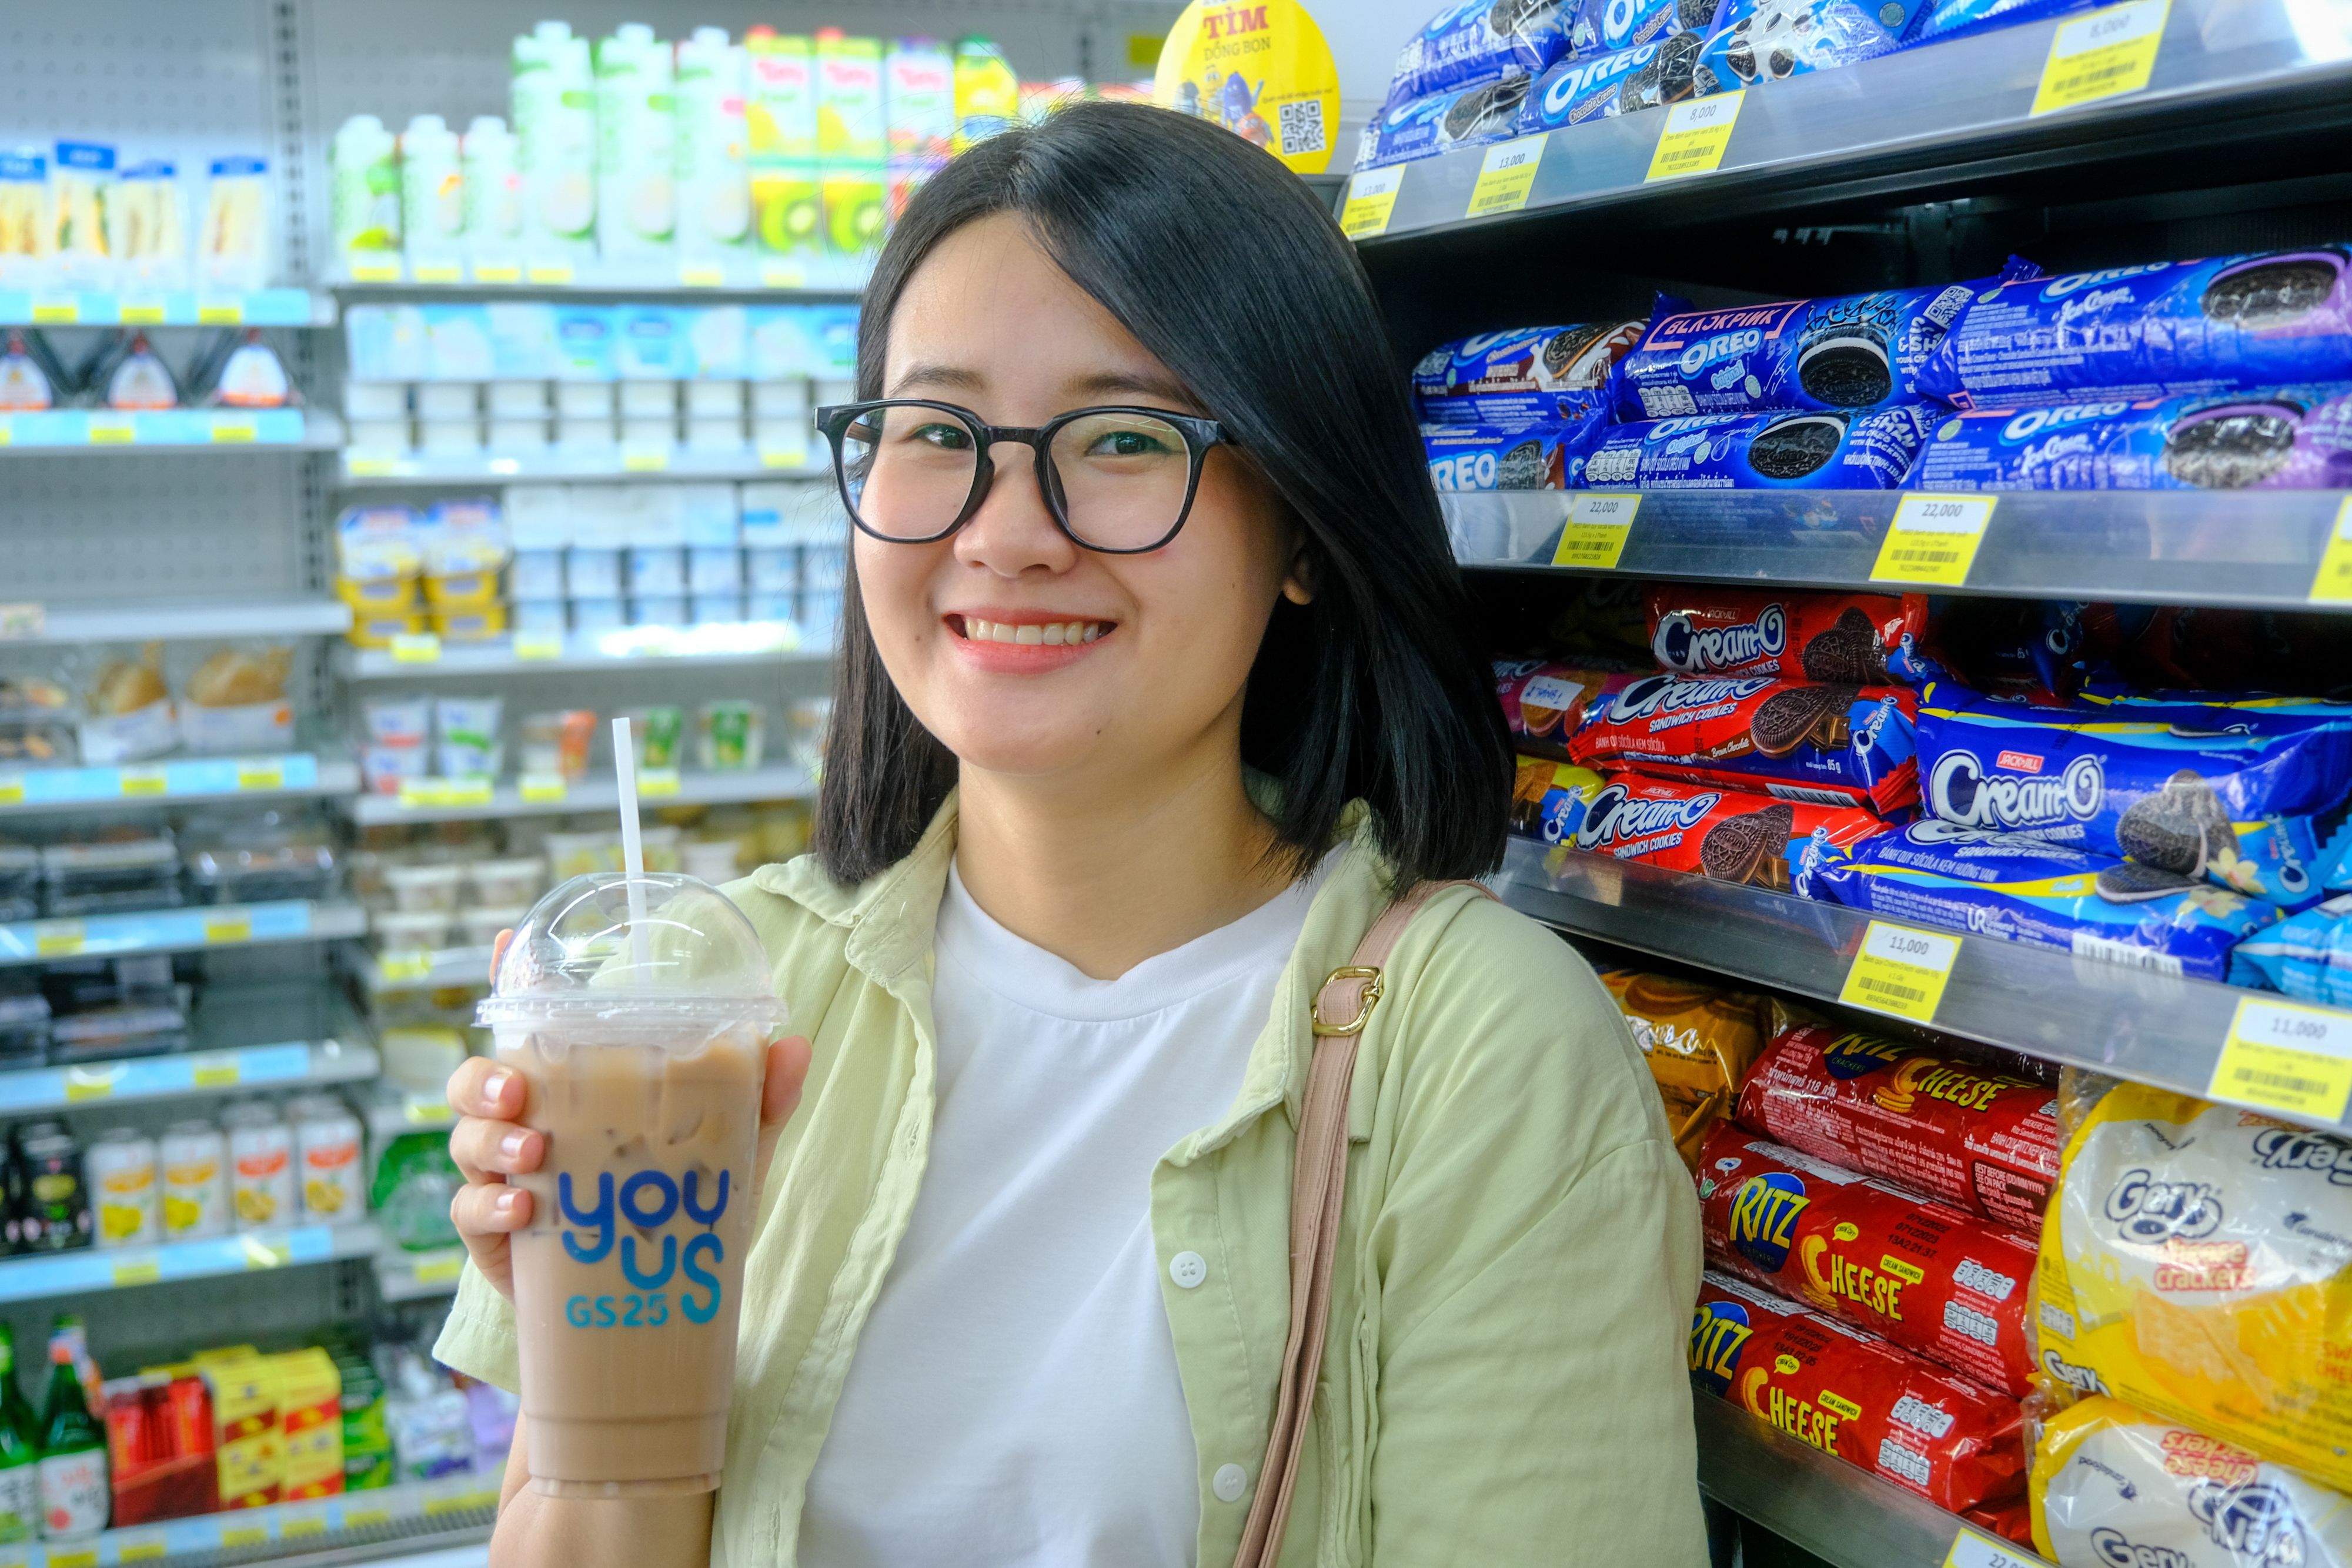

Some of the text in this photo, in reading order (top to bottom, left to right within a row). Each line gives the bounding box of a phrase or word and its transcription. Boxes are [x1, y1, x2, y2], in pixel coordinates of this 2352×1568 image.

[1544, 43, 1656, 115] OREO
[1689, 104, 1717, 122] 8,000
[1499, 153, 1525, 169] 13,000
[1680, 329, 1760, 375] OREO
[1711, 360, 1745, 390] Original
[1648, 414, 1738, 440] OREO
[2004, 402, 2127, 440] OREO
[1666, 430, 1709, 455] Original
[1429, 453, 1496, 489] REO
[1589, 502, 1619, 514] 22,000
[1921, 503, 1963, 519] 22,000
[1749, 660, 1780, 677] COOKIES
[1649, 702, 1738, 733] SANDWICH COOKIES
[1635, 738, 1647, 751] KEM
[2046, 823, 2084, 840] COOKIES
[1613, 831, 1683, 858] SANDWICH COOKIES
[1877, 846, 1899, 862] BÁNH
[1897, 850, 1914, 865] QUY
[1937, 858, 1956, 874] KEM
[1889, 935, 1929, 955] 11,000
[1806, 1078, 1822, 1093] 118
[1975, 1162, 1987, 1174] BEST
[1986, 1165, 2006, 1179] BEFORE
[1975, 1174, 2007, 1192] SEE ON PACK
[1729, 1176, 1811, 1249] RITZ
[1895, 1222, 1939, 1244] 07122023
[1883, 1258, 1921, 1281] CREAM SANDWICH
[2155, 1265, 2256, 1291] crackers
[565, 1293, 670, 1329] GS25
[1820, 1393, 1859, 1417] CREAM SANDWICH
